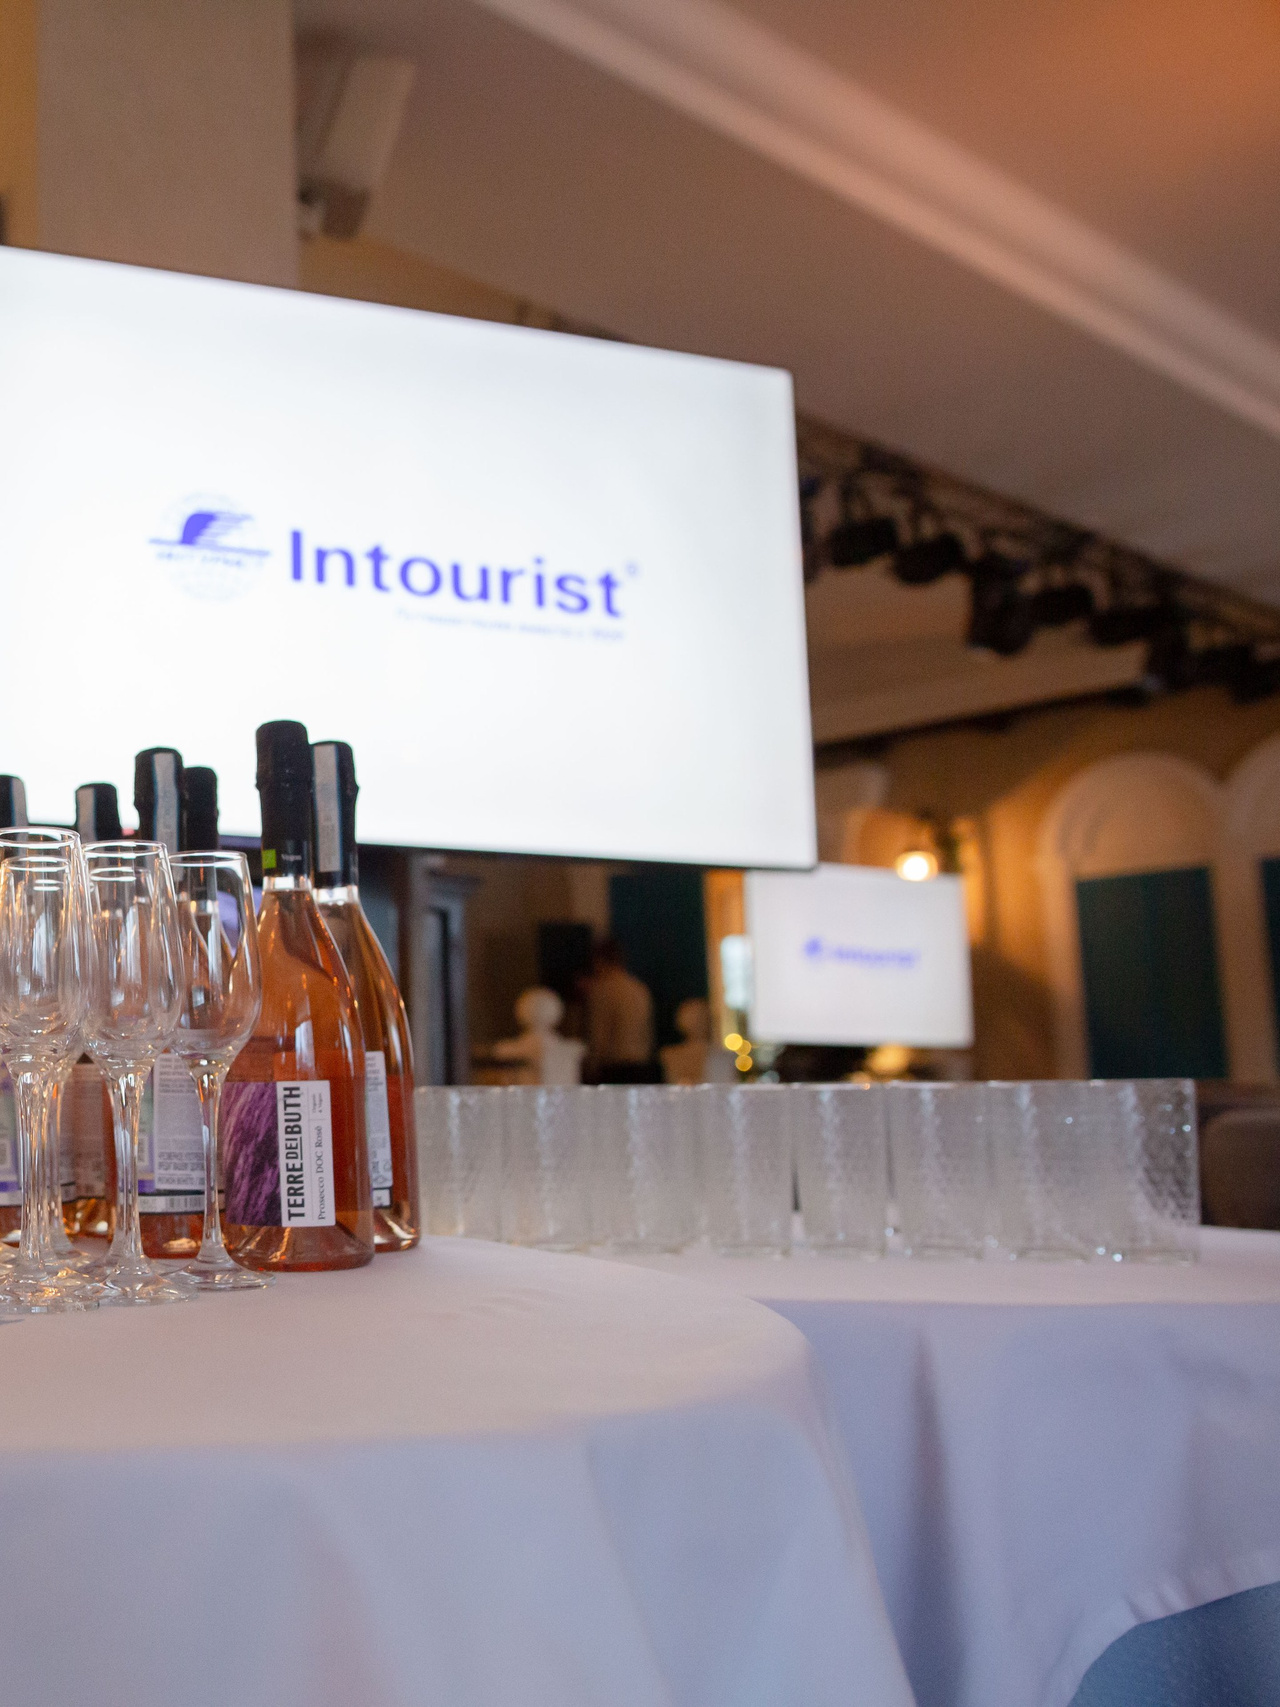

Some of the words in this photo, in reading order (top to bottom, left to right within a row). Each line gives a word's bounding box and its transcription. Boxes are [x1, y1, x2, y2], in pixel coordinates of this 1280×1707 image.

[290, 529, 622, 618] Intourist
[283, 1086, 302, 1135] BUTH
[284, 1137, 300, 1160] DEI
[315, 1151, 324, 1174] DOC
[287, 1162, 305, 1221] TERRE
[316, 1176, 326, 1221] Prosecco
